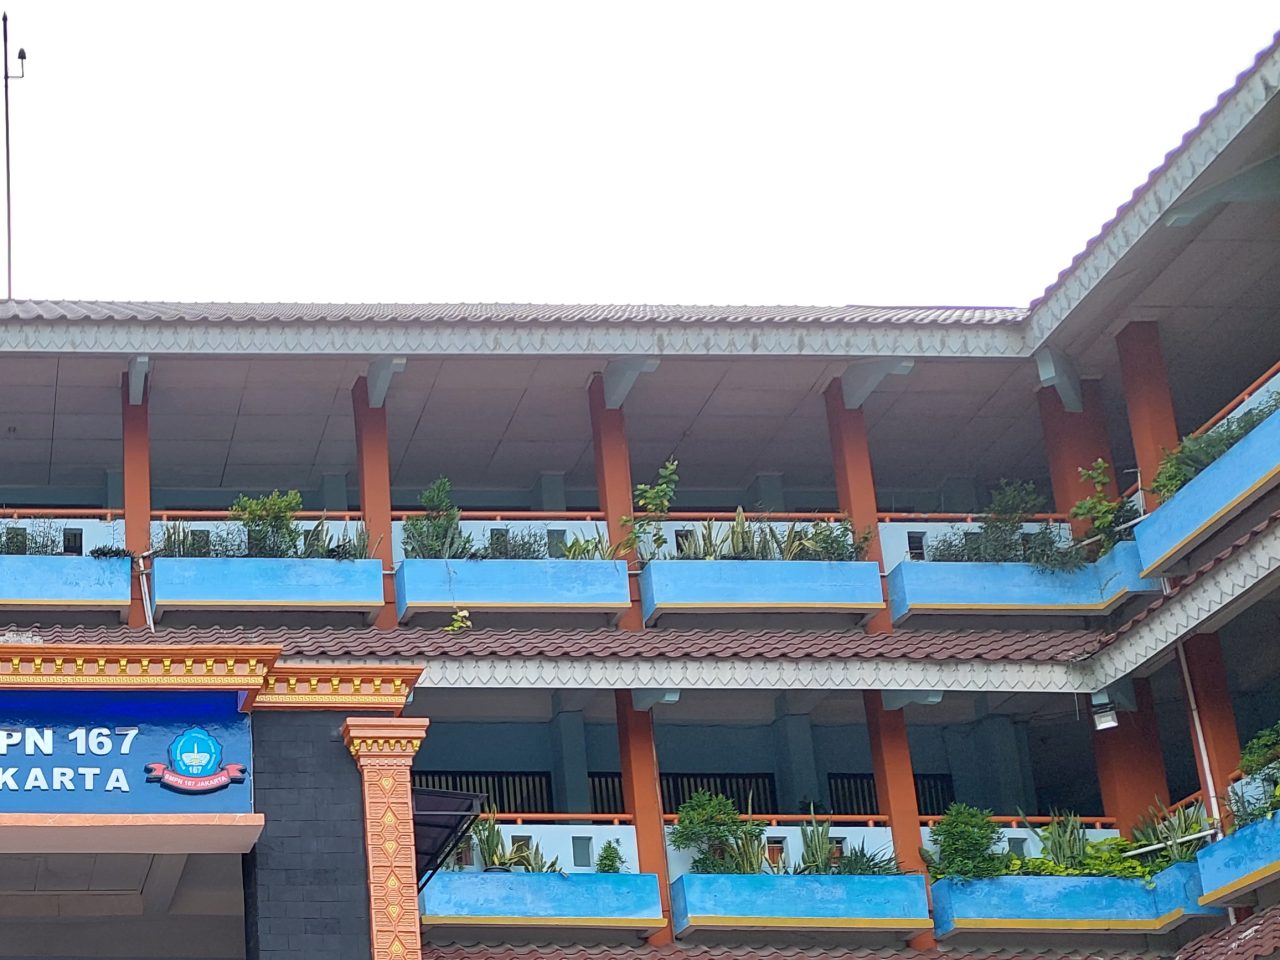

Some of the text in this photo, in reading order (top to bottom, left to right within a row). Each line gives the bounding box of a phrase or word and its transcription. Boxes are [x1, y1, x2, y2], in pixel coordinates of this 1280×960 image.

[69, 726, 139, 756] 167
[188, 766, 203, 774] 167
[164, 774, 184, 785] SMPN
[196, 775, 228, 787] JAKARTA
